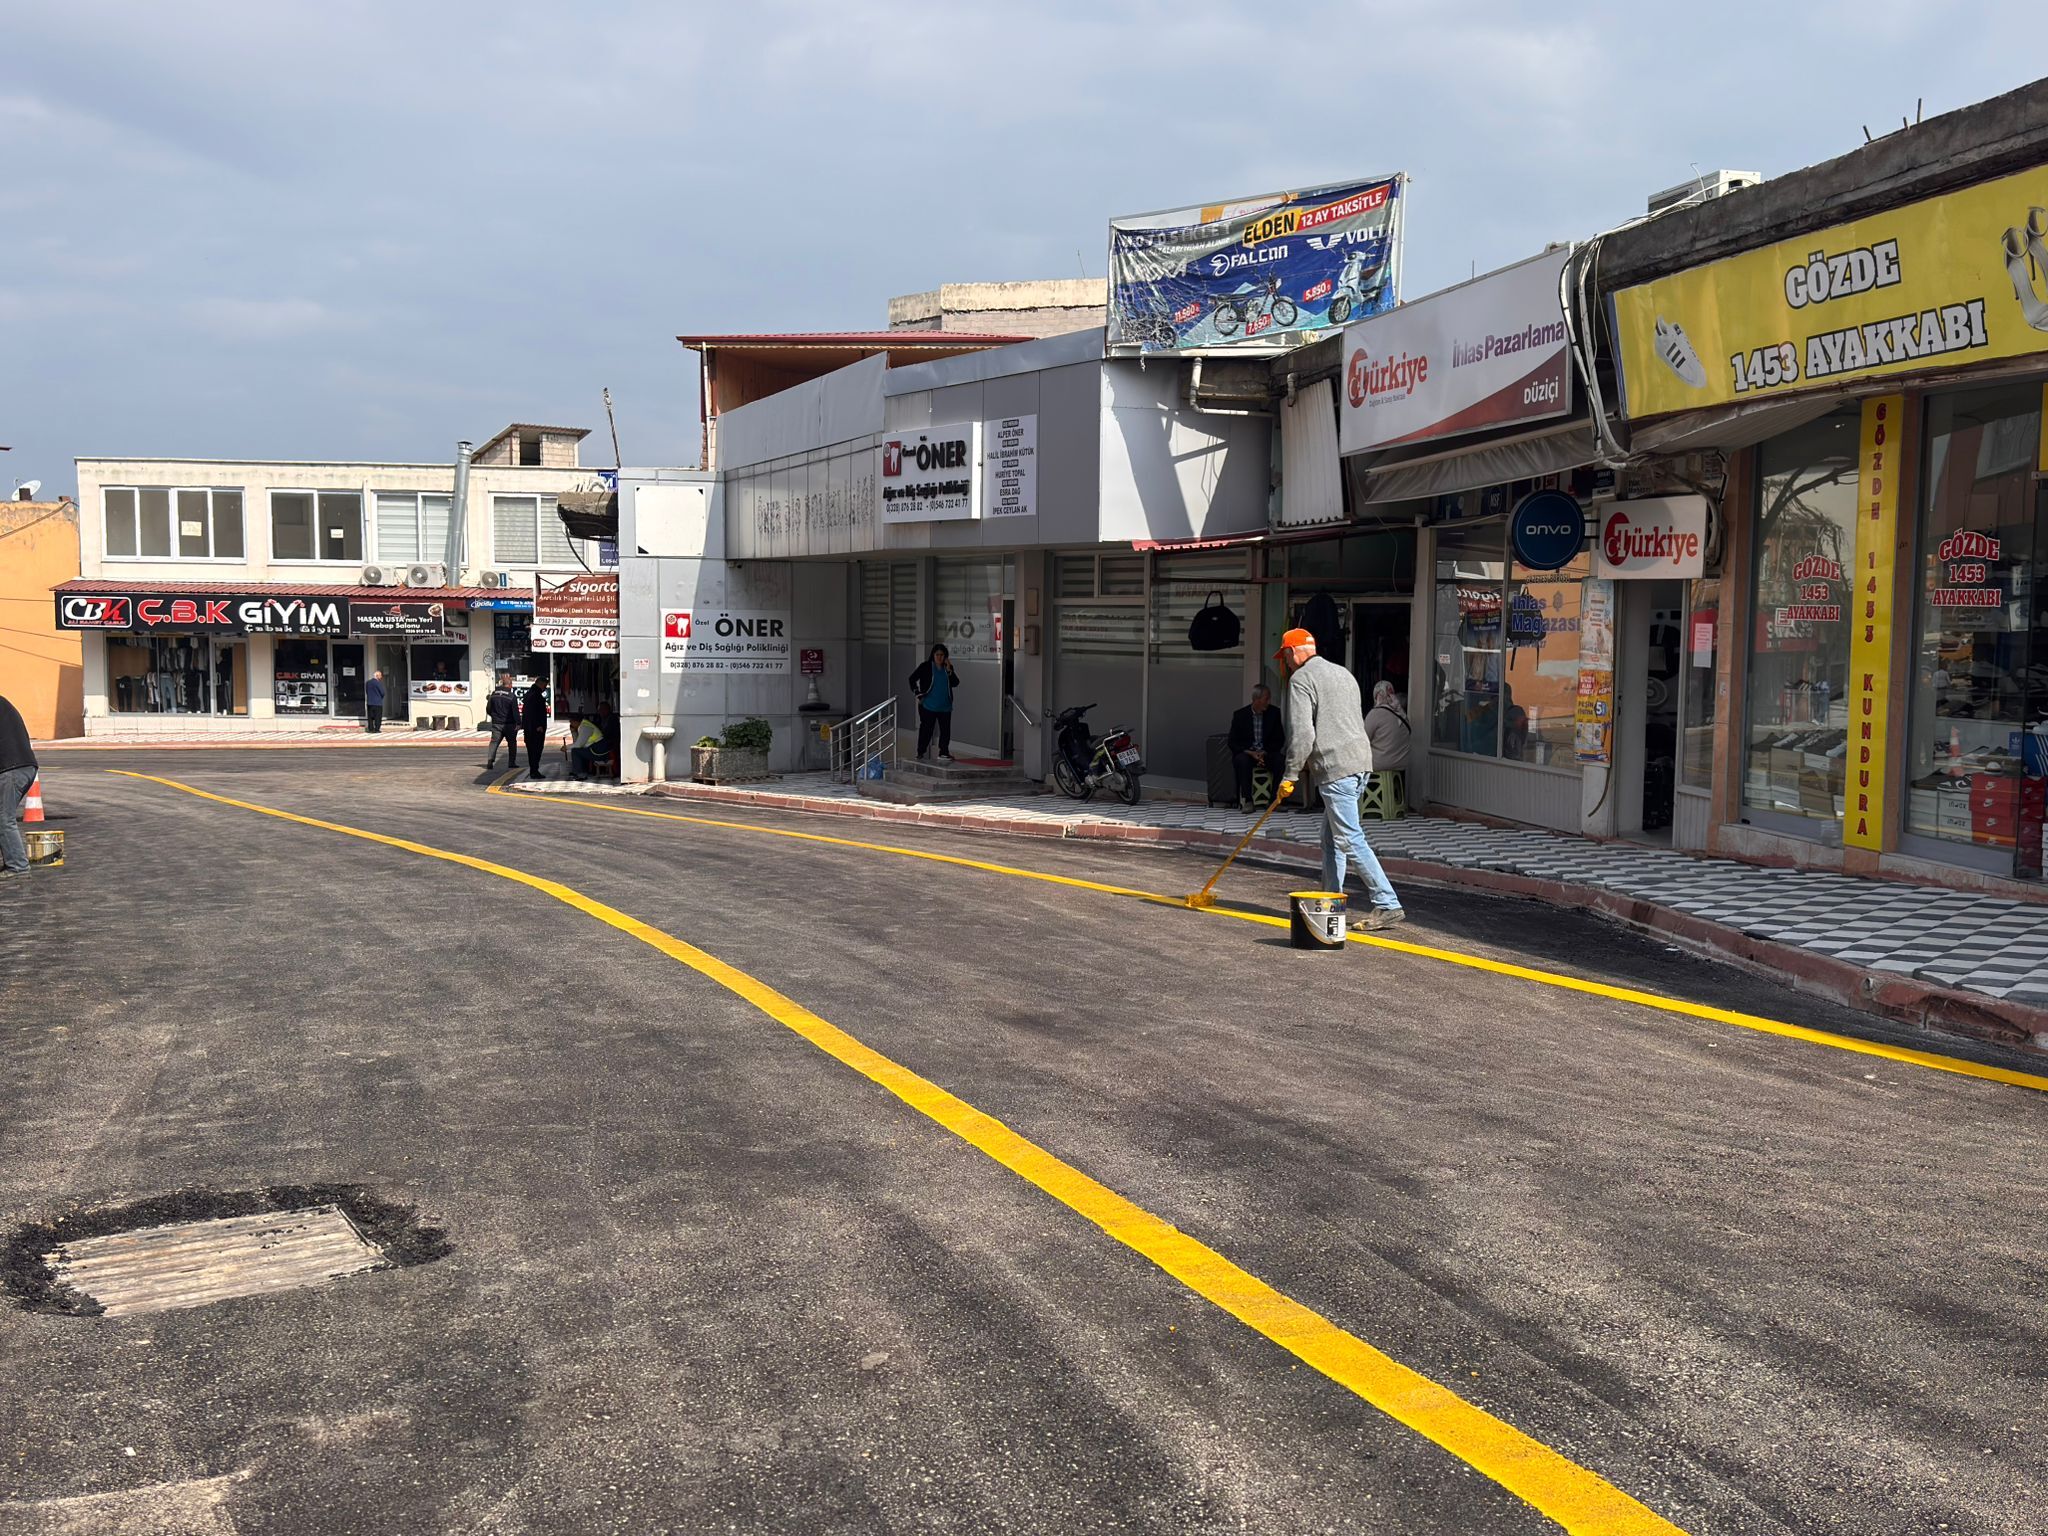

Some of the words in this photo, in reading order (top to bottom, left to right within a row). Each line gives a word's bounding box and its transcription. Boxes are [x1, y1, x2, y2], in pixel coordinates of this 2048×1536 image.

[1243, 212, 1295, 244] ELDEN
[1301, 215, 1313, 228] 12
[1314, 211, 1328, 224] AY
[1331, 192, 1383, 219] TAKSİTLE
[1785, 238, 1901, 309] GÖZDE
[1730, 341, 1799, 393] 1453
[1805, 298, 1988, 379] AYAKKABI
[1348, 348, 1428, 408] Türkiye
[997, 430, 1011, 438] ALPER
[1012, 427, 1024, 437] ÖNER
[916, 436, 967, 471] ÖNER
[1012, 469, 1025, 478] TOPAL
[999, 488, 1011, 497] ESRA
[961, 499, 968, 507] 77
[1003, 506, 1021, 514] CEYLAN
[1021, 505, 1027, 513] AK
[1603, 511, 1698, 565] Türkiye
[1938, 527, 2001, 561] GÖZDE
[1792, 551, 1840, 581] GÖZDE
[1949, 563, 1986, 583] 1453
[569, 581, 618, 595] sigorta
[1801, 582, 1829, 600] 1453
[1865, 551, 1876, 643] 1453
[1932, 588, 2002, 607] AYAKKABI
[137, 599, 233, 627] Ç.B.K
[239, 599, 341, 626] GİYİM
[1786, 605, 1840, 621] AYAKKABI
[244, 624, 293, 633] Çabuk
[299, 625, 341, 634] Giyin
[540, 626, 569, 635] emir
[570, 627, 617, 638] sigorta
[715, 613, 784, 637] ÖNER
[1511, 612, 1582, 637] Mağazası
[665, 642, 684, 653] Ağız
[699, 643, 713, 653] Diş
[715, 643, 744, 653] Sağlığı
[746, 643, 789, 653] Polikliniği
[670, 661, 691, 670] 0(328)
[729, 662, 751, 670] (0)546
[1857, 673, 1874, 836] KUNDURA
